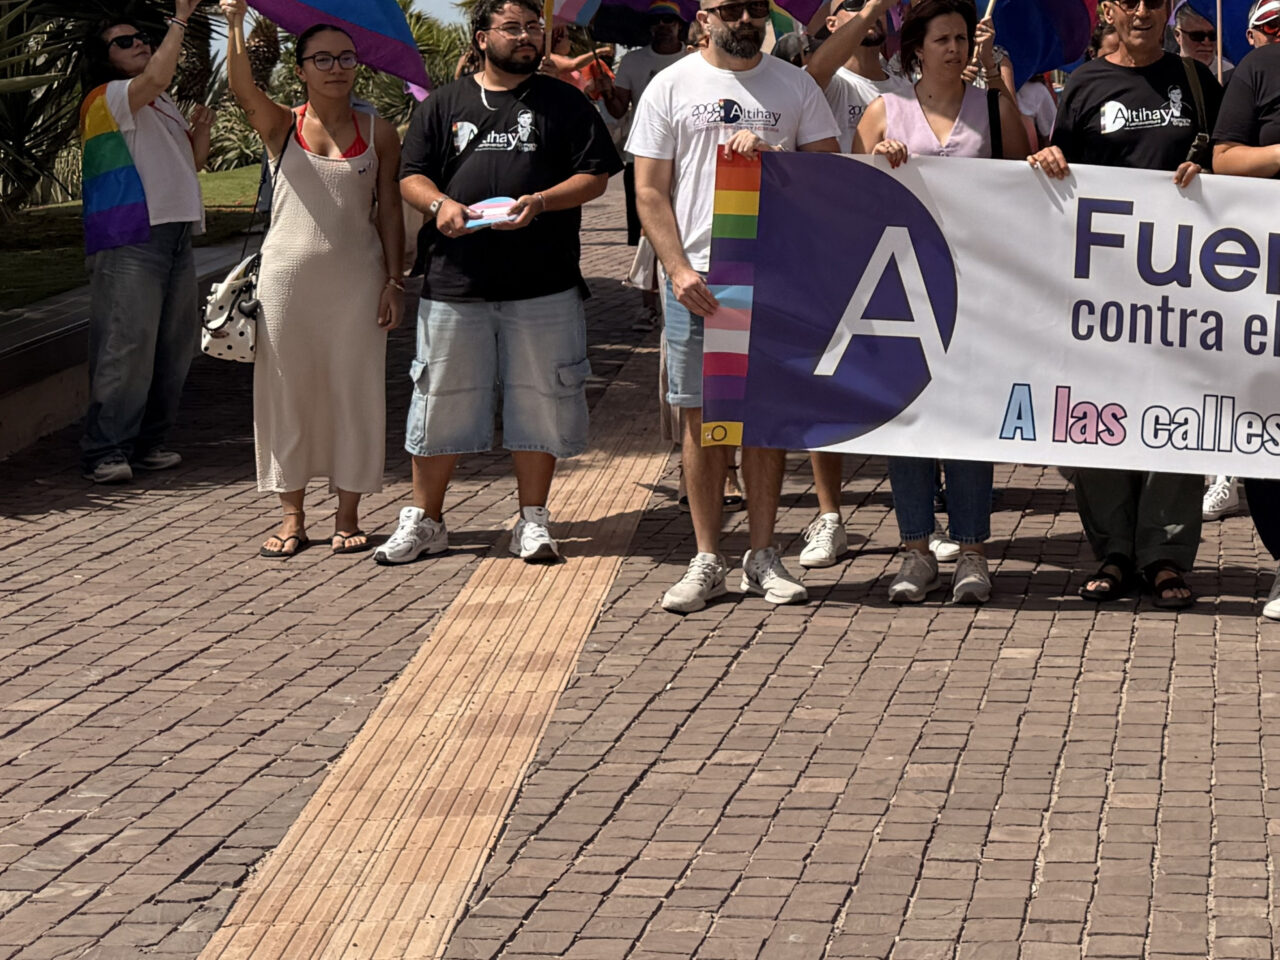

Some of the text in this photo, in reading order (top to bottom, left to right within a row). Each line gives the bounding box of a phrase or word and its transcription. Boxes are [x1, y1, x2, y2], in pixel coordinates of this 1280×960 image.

[730, 104, 781, 126] Altihay
[1112, 107, 1173, 126] Altihay
[1071, 295, 1224, 352] contra
[1000, 383, 1036, 440] A
[1053, 386, 1127, 445] las
